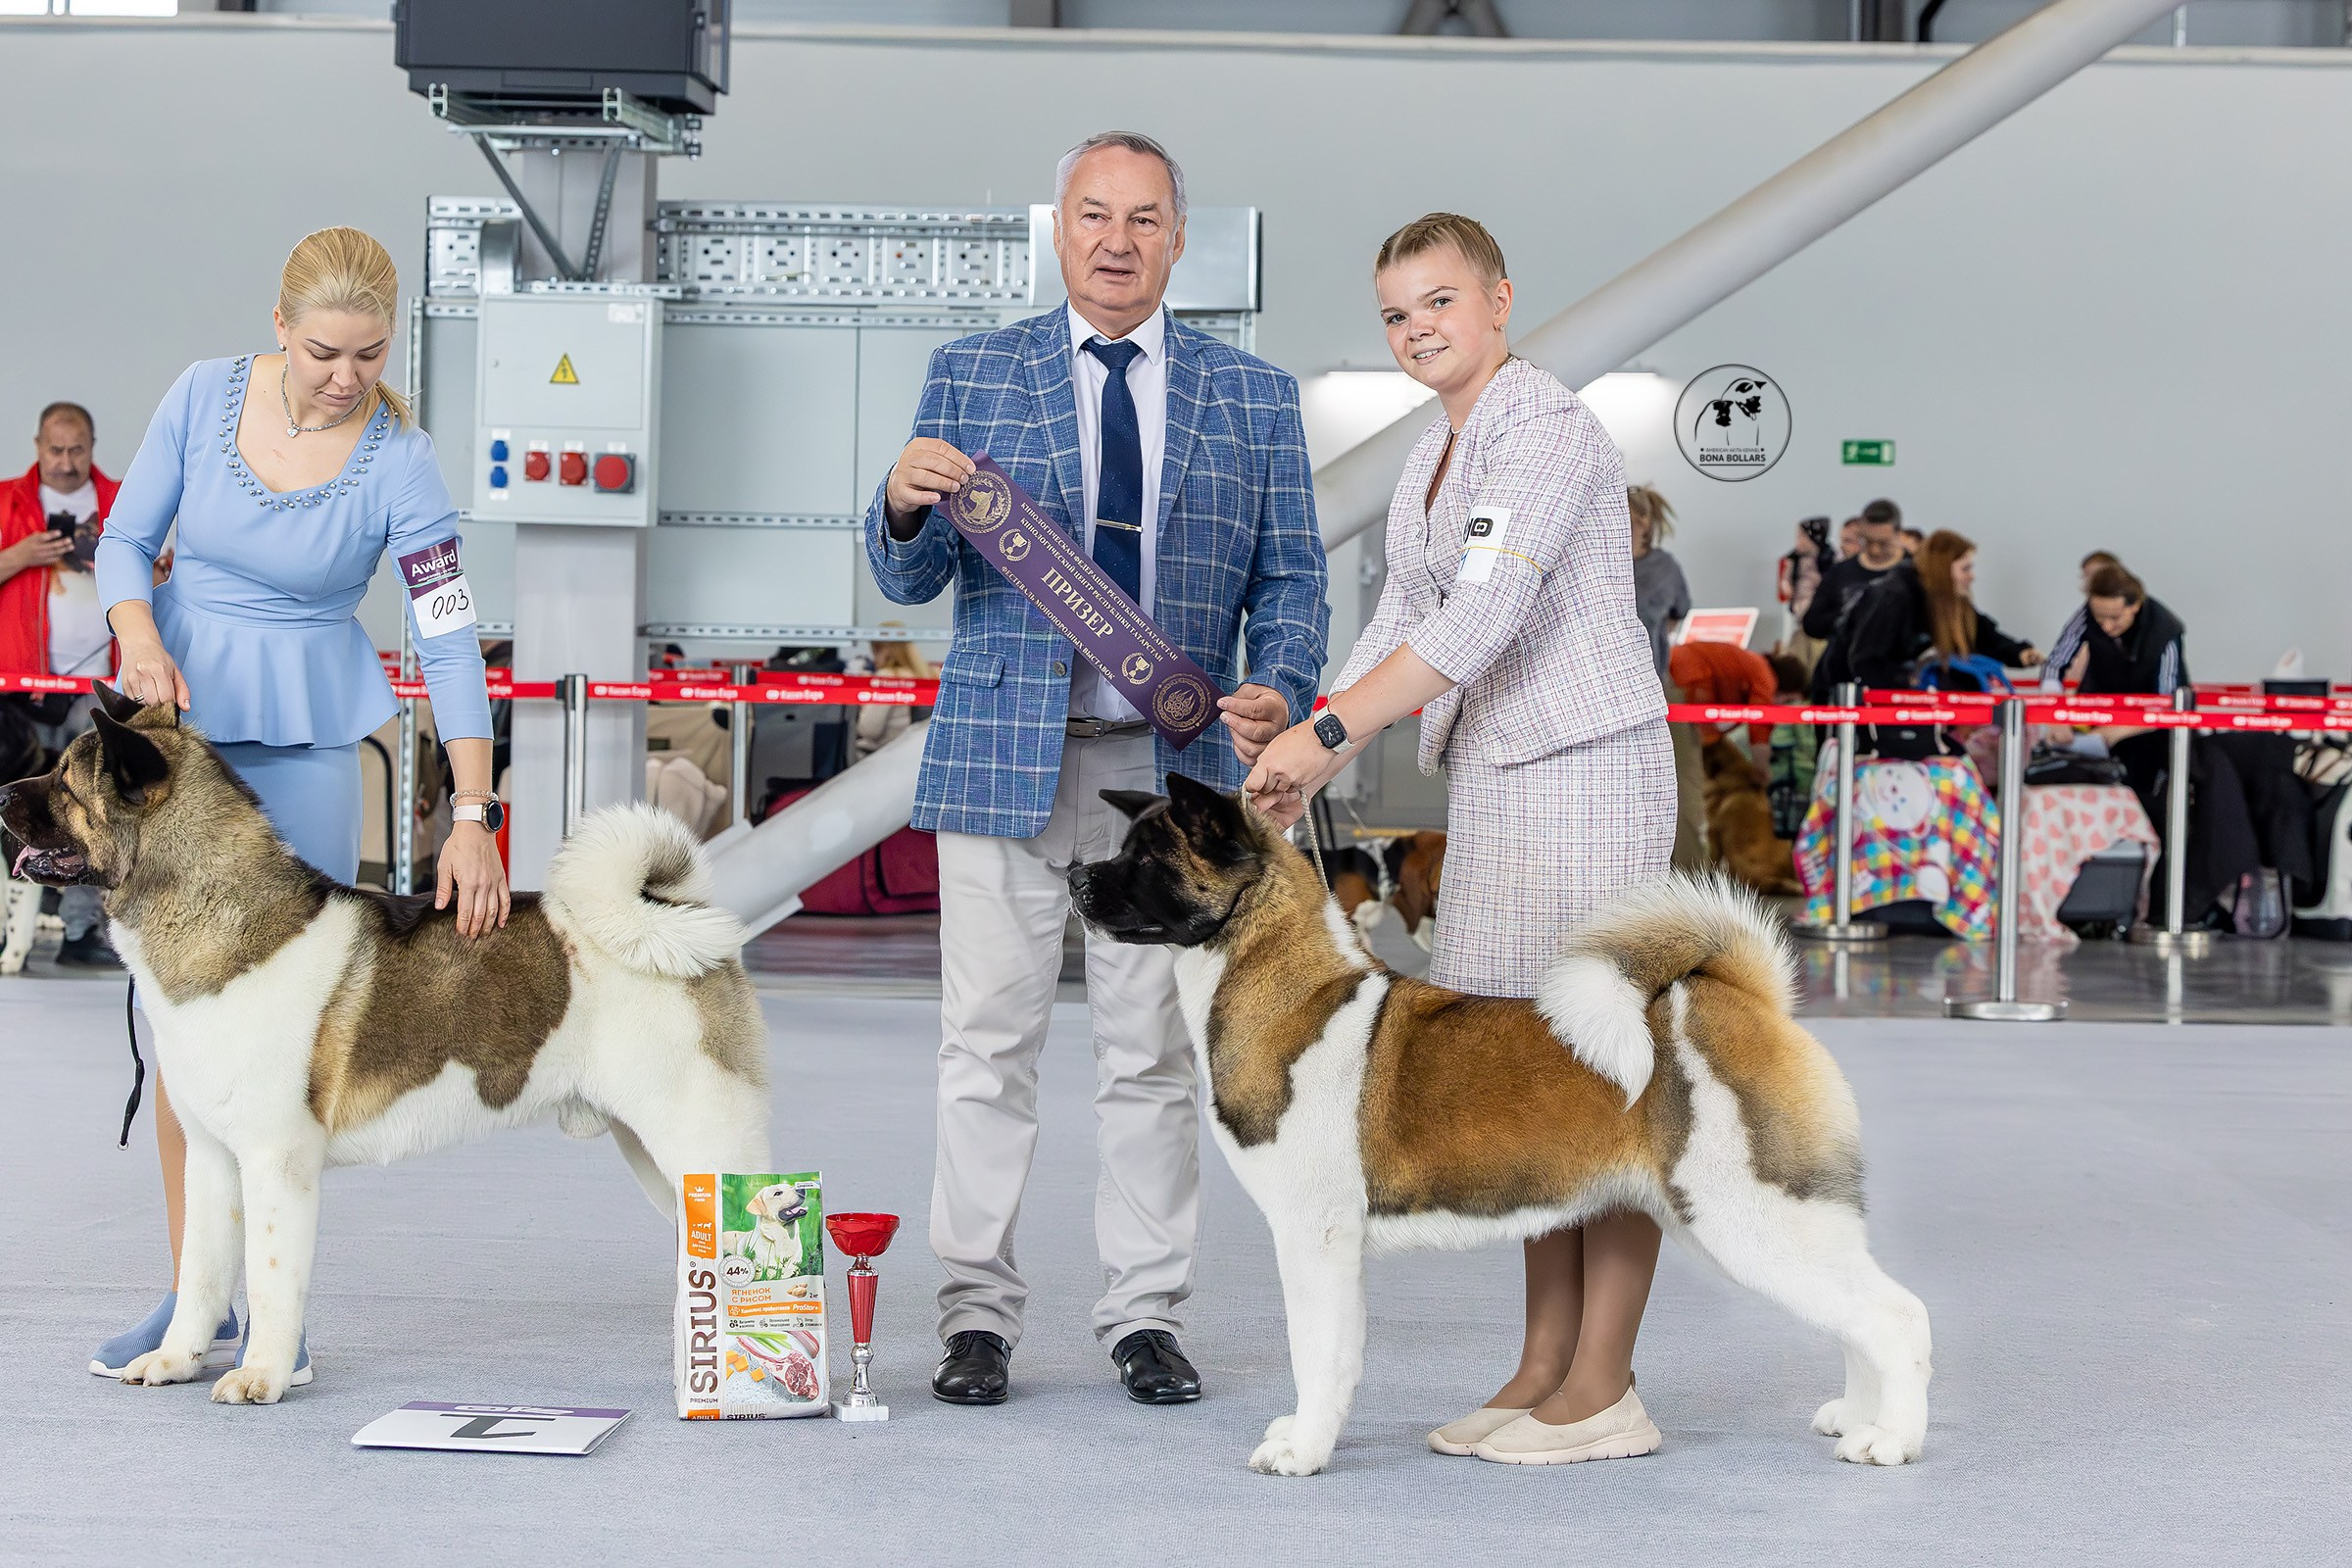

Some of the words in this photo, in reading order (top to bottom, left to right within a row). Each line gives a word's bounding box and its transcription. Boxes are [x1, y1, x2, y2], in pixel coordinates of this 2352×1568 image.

[412, 549, 457, 578] Award
[1020, 502, 1075, 557] КИНОЛОГИЧЕСКАЯ
[1073, 554, 1109, 590] ФЕДЕРАЦИЯ
[1107, 589, 1146, 628] РЕСПУБЛИКИ
[1144, 626, 1178, 661] ТАТАРСТАН
[1020, 517, 1076, 573] КИНОЛОГИЧЕСКИЙ
[1073, 570, 1094, 591] ЦЕНТР
[1092, 590, 1131, 629] РЕСПУБЛИКИ
[1129, 626, 1164, 662] ТАТАРСТАН
[432, 588, 469, 619] 003
[1041, 566, 1114, 638] ПРИЗЕР
[1034, 599, 1084, 650] МОНОПОРОДНЫХ
[1082, 647, 1116, 681] ВЫСТАВОК
[691, 1230, 712, 1242] ADULT
[726, 1266, 749, 1276] 44%
[731, 1287, 771, 1296] ЯГНЕНОК
[740, 1295, 772, 1303] РИСОМ
[792, 1303, 819, 1312] ProStor+
[688, 1270, 718, 1393] SIRIUS
